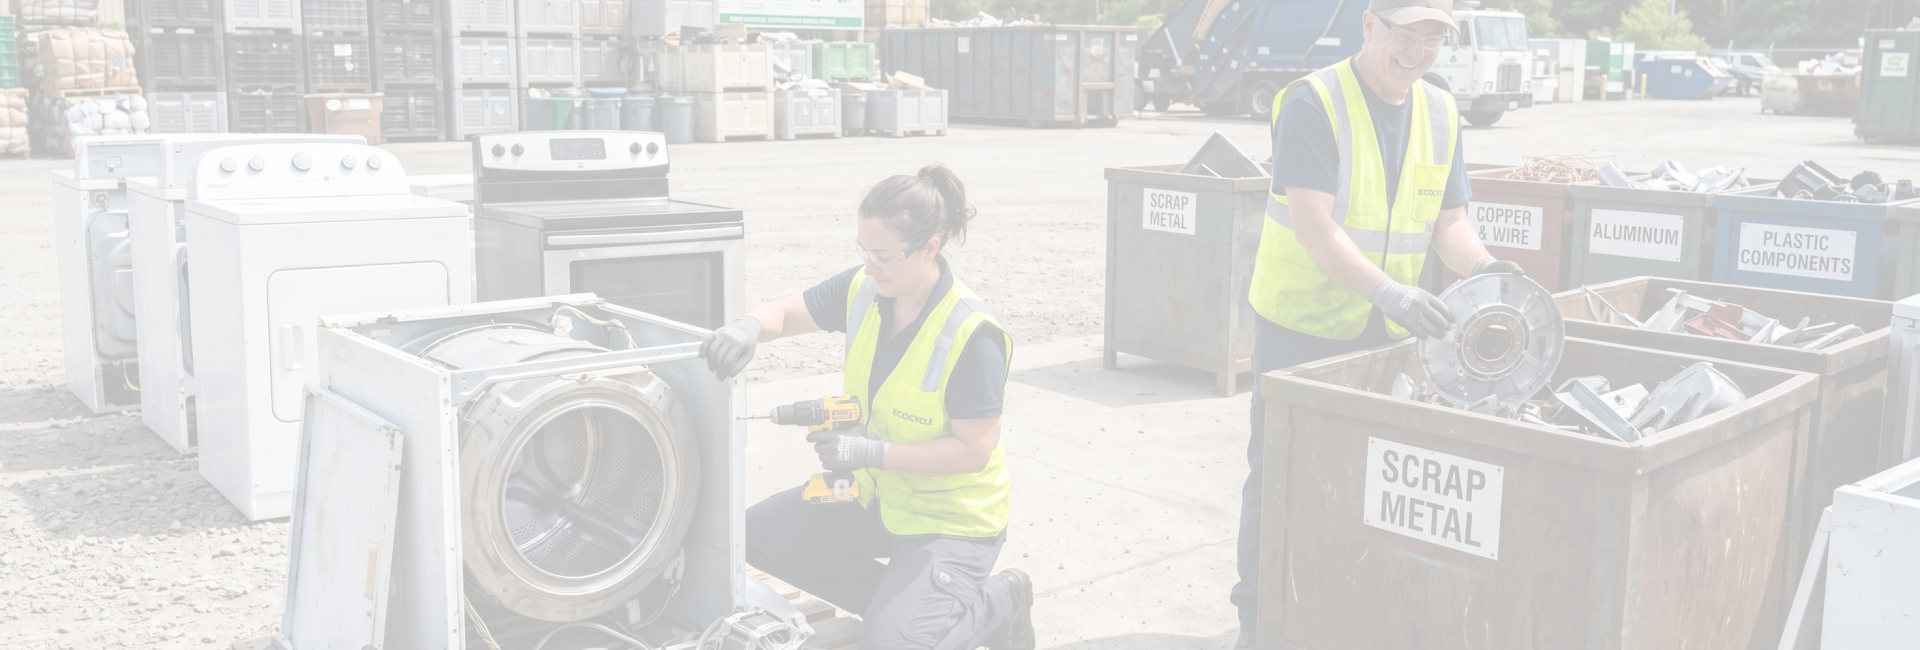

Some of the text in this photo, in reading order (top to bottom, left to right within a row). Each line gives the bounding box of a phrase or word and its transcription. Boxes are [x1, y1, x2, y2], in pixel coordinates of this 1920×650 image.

[1150, 192, 1189, 210] SCRAP
[1417, 188, 1444, 197] ECOCYC
[1150, 210, 1188, 229] METAL
[1476, 206, 1532, 227] COPPER
[1478, 225, 1530, 246] & WIRE
[1592, 222, 1680, 246] ALUMINUM
[1762, 230, 1830, 252] PLASTIC
[1740, 248, 1853, 275] COMPONENTS
[892, 407, 935, 426] ECOCYCLE
[1381, 449, 1487, 503] SCRAP
[1380, 489, 1482, 548] METAL
